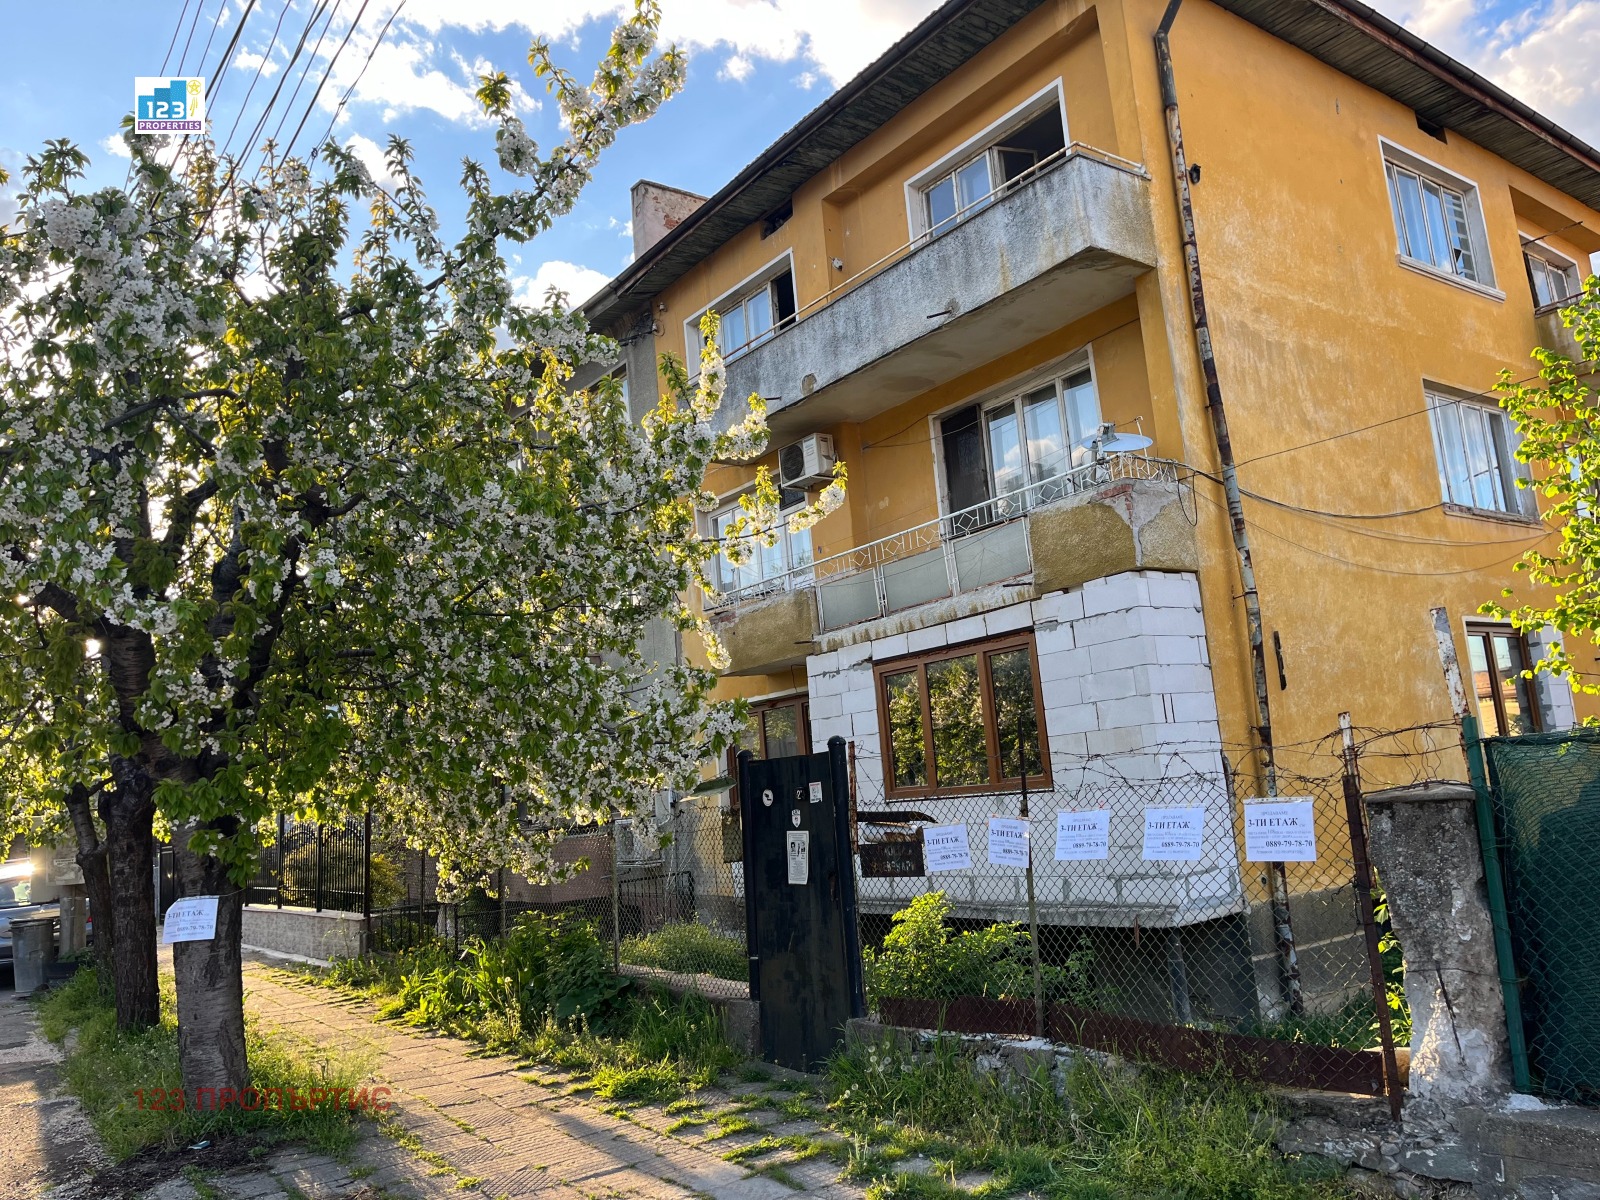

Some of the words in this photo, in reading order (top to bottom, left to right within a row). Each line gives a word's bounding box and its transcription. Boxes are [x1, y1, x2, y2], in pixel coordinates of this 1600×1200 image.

[1167, 821, 1190, 829] ЕТАЖ
[1248, 819, 1267, 827] 3-ТИ
[1270, 818, 1298, 826] ЕТАЖ
